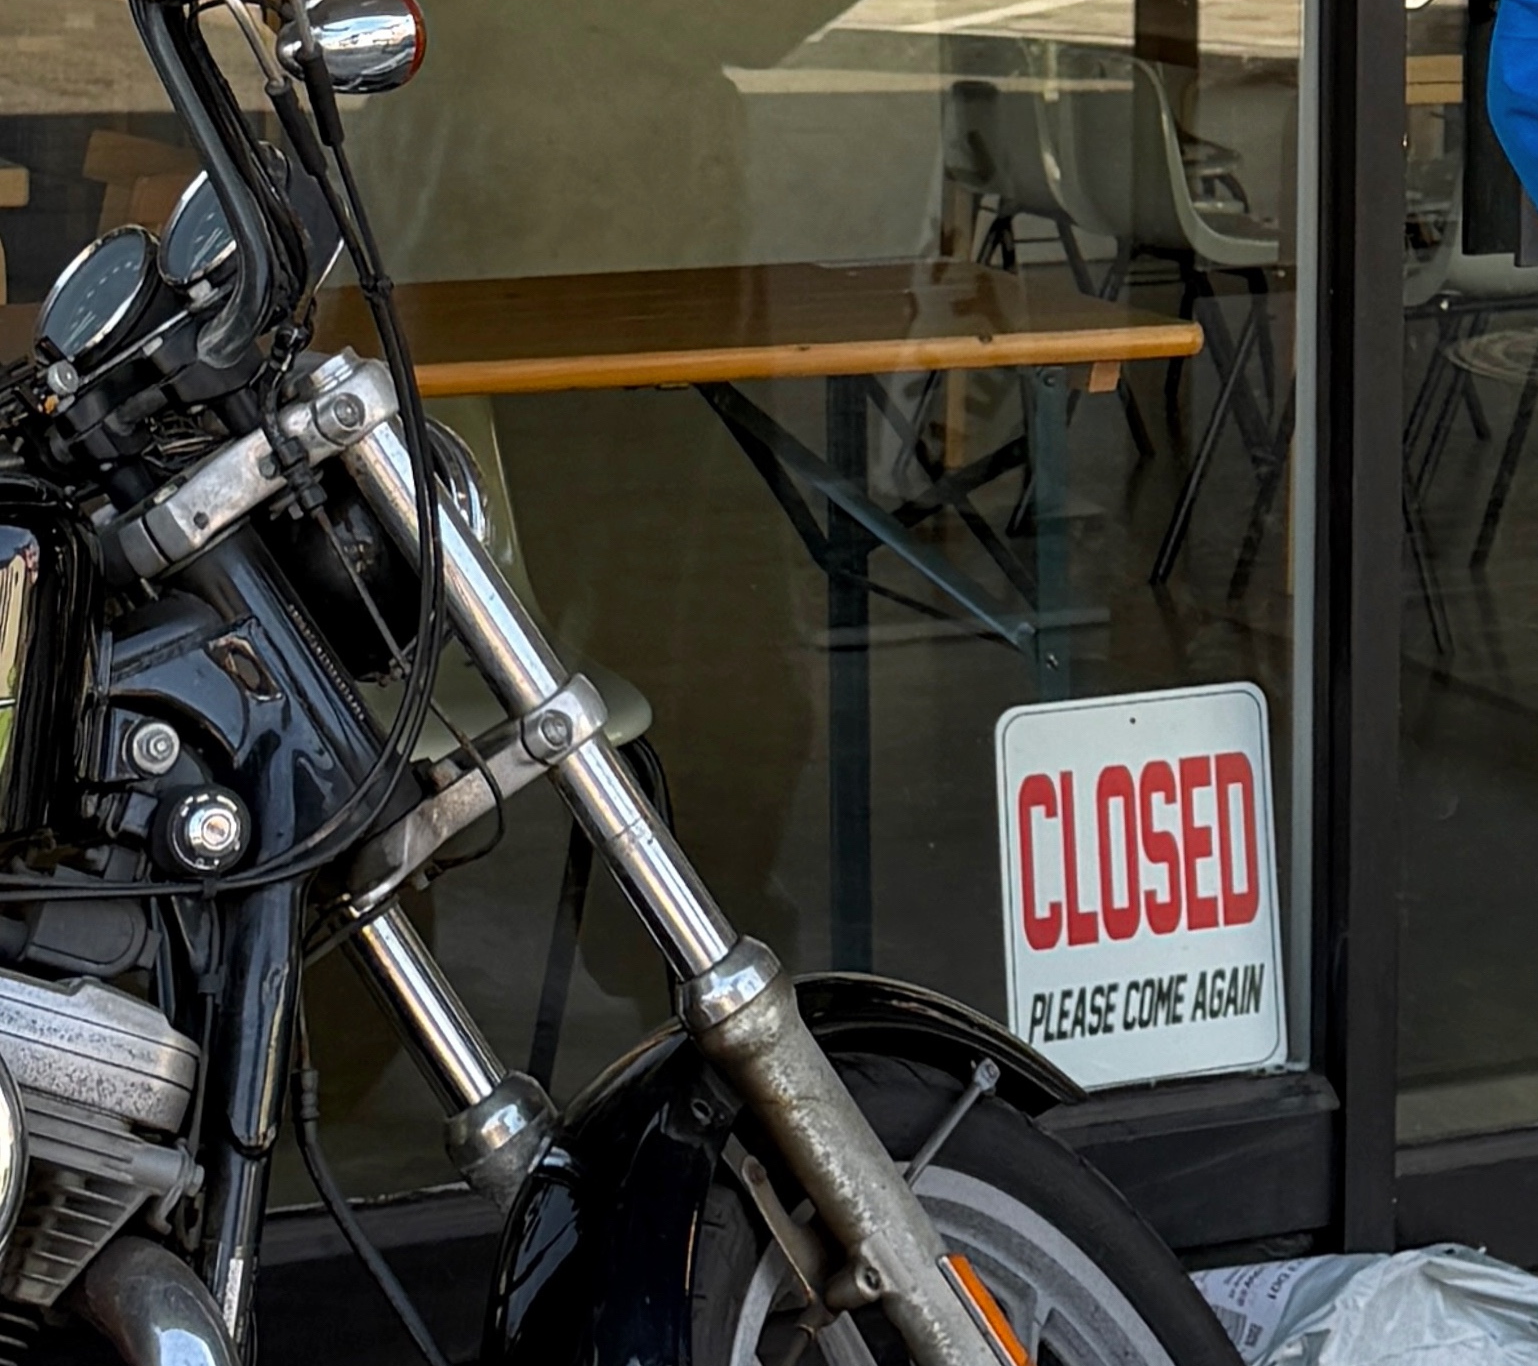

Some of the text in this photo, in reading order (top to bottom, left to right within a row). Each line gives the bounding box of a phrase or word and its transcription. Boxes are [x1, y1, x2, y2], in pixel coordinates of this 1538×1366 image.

[1018, 751, 1260, 951] CLOSED
[1029, 962, 1265, 1044] PLEASE COME AGAIN
